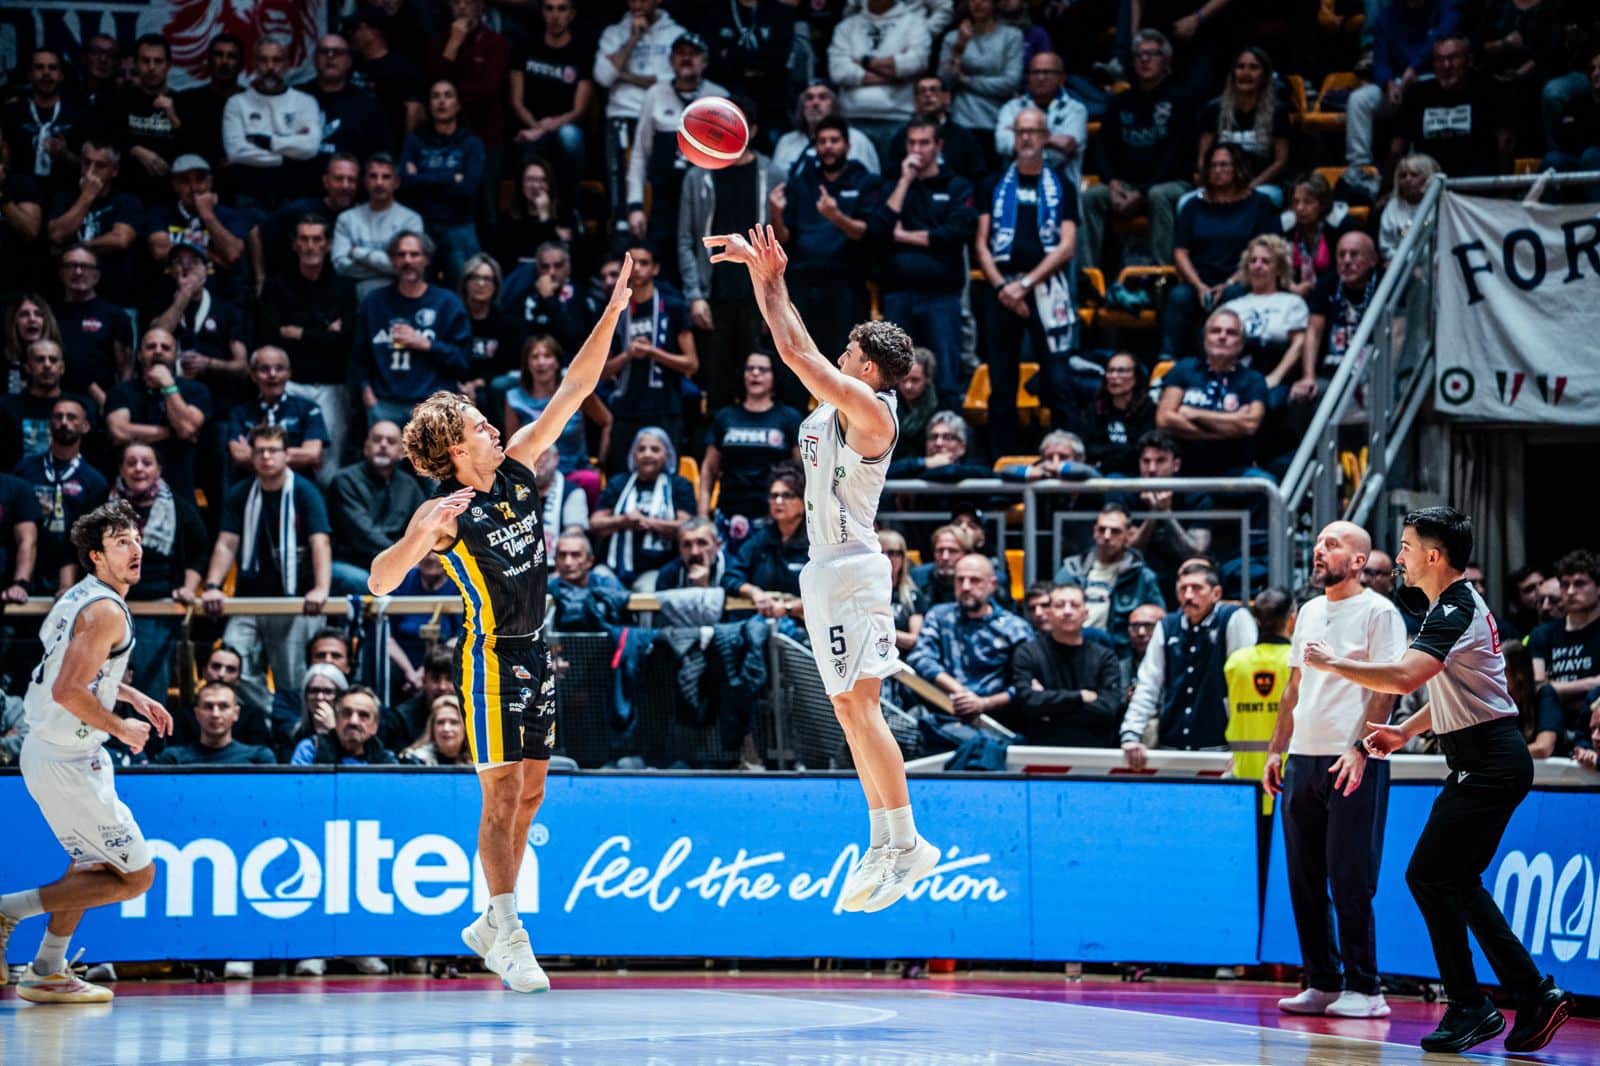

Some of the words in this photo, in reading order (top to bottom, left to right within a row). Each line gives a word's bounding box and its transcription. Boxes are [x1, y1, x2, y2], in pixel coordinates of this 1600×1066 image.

[1451, 219, 1600, 305] FOR
[390, 351, 410, 370] 11
[829, 625, 846, 656] 5
[121, 820, 539, 918] molten
[564, 836, 692, 913] feel
[685, 848, 785, 908] the
